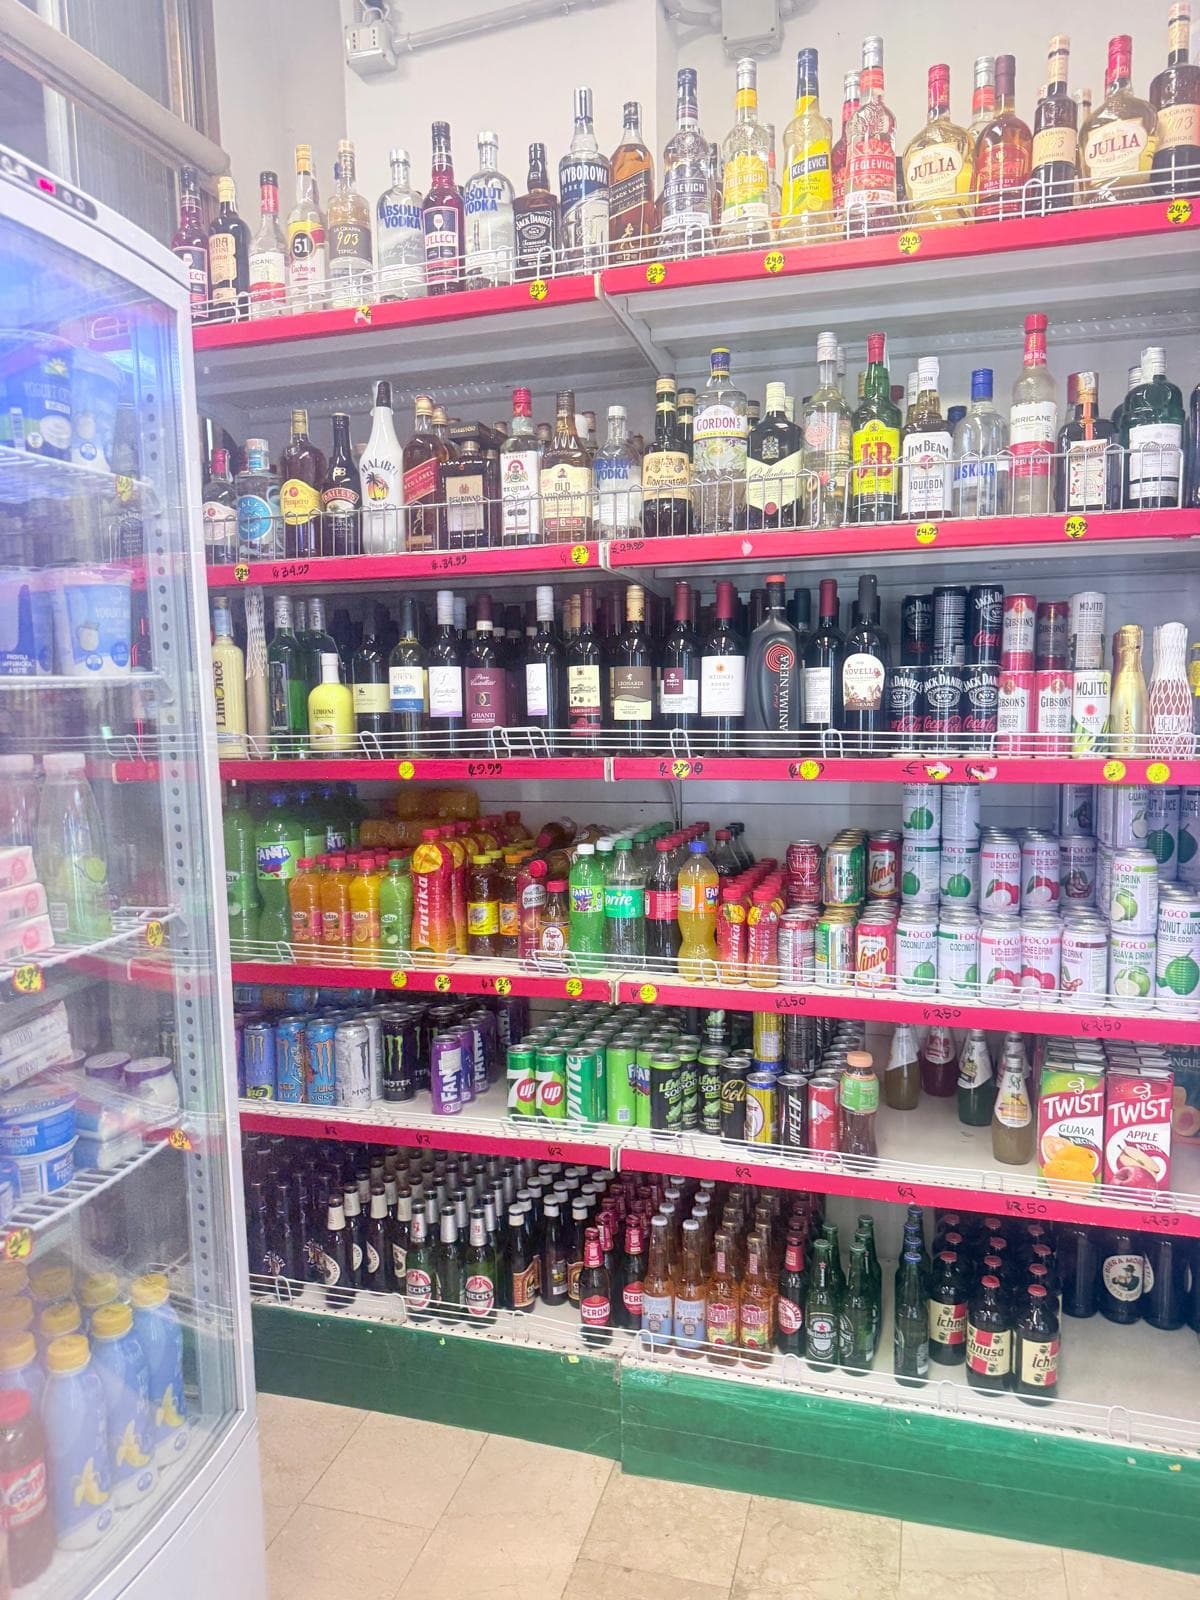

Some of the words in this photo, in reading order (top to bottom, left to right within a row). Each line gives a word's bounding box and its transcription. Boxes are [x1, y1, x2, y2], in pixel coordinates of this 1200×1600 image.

[1089, 133, 1141, 159] JULIA
[791, 156, 827, 177] KEGEVICH
[911, 157, 956, 181] JULIA
[379, 203, 423, 219] ABSOLU
[464, 198, 498, 217] VODKA
[384, 215, 421, 231] VODKA
[293, 237, 310, 253] 51
[425, 232, 457, 247] SELECT
[908, 444, 924, 458] JIM
[924, 440, 949, 456] BEAM
[554, 481, 571, 492] OLD
[779, 654, 789, 692] NERA
[1075, 682, 1108, 696] MOJITO
[779, 694, 789, 731] ANIMA
[605, 893, 633, 906] prite
[418, 876, 429, 947] Frutika
[1163, 909, 1189, 920] FOCO
[908, 931, 932, 939] FOCO
[1120, 940, 1147, 949] FOCO
[1043, 1093, 1103, 1121] TWIST
[1108, 1098, 1170, 1127] TWIST
[1058, 1124, 1096, 1137] GUAVA
[1126, 1130, 1159, 1142] APPLE
